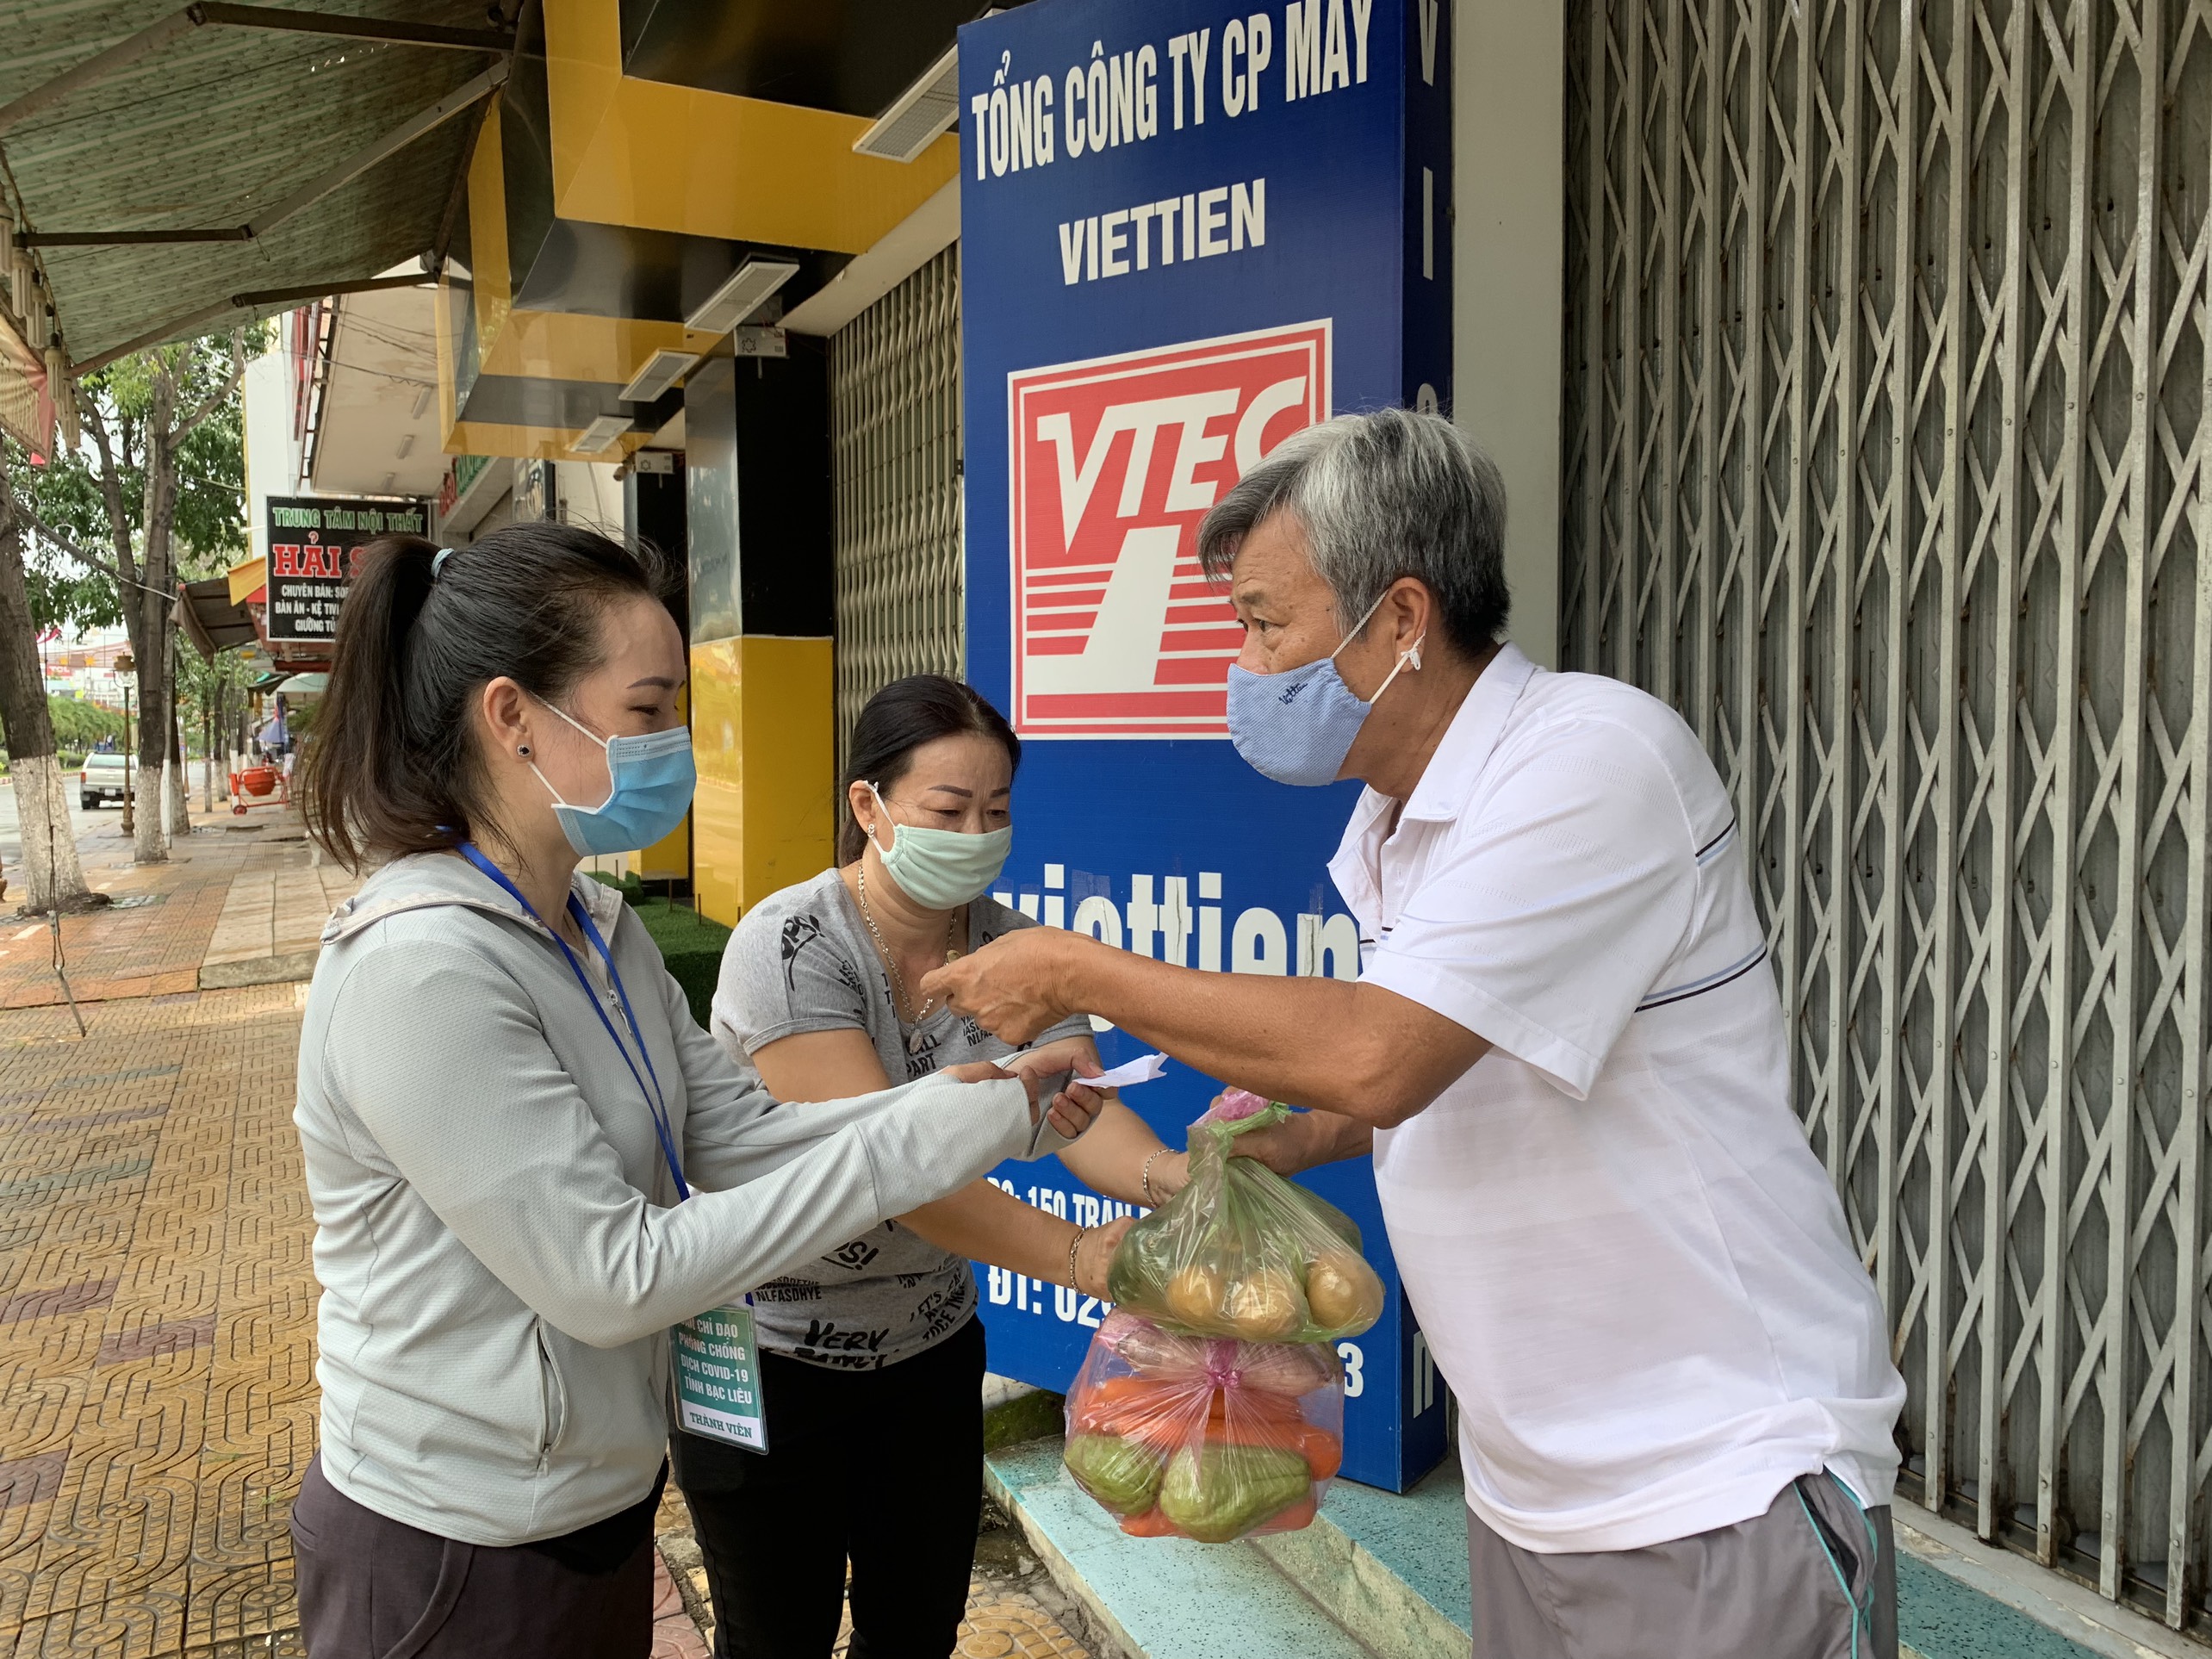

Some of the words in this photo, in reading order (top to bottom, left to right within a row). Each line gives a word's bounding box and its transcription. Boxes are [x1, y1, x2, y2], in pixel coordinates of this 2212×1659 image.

[972, 49, 1053, 181] TỔNG
[1064, 40, 1158, 158] CÔNG
[1169, 28, 1210, 130] TY
[1222, 13, 1272, 118] CP
[1285, 0, 1373, 103] MAY
[1059, 177, 1265, 286] VIETTIEN
[273, 506, 320, 528] TRUNG
[324, 506, 355, 530] TÂM
[357, 508, 383, 535] NỘI
[387, 506, 423, 532] THẤT
[272, 531, 342, 578] HẢI
[282, 582, 314, 598] CHUYÊN
[697, 1317, 714, 1336] CHỈ
[716, 1322, 738, 1341] ĐẠO
[708, 1340, 746, 1361] CHỐNG
[701, 1361, 749, 1382] COVID-19
[684, 1372, 705, 1395] TỈNH
[706, 1383, 726, 1401] BẠC
[727, 1387, 752, 1404] LIÊU
[690, 1413, 725, 1432] THÀNH
[727, 1422, 753, 1438] VIÊN
